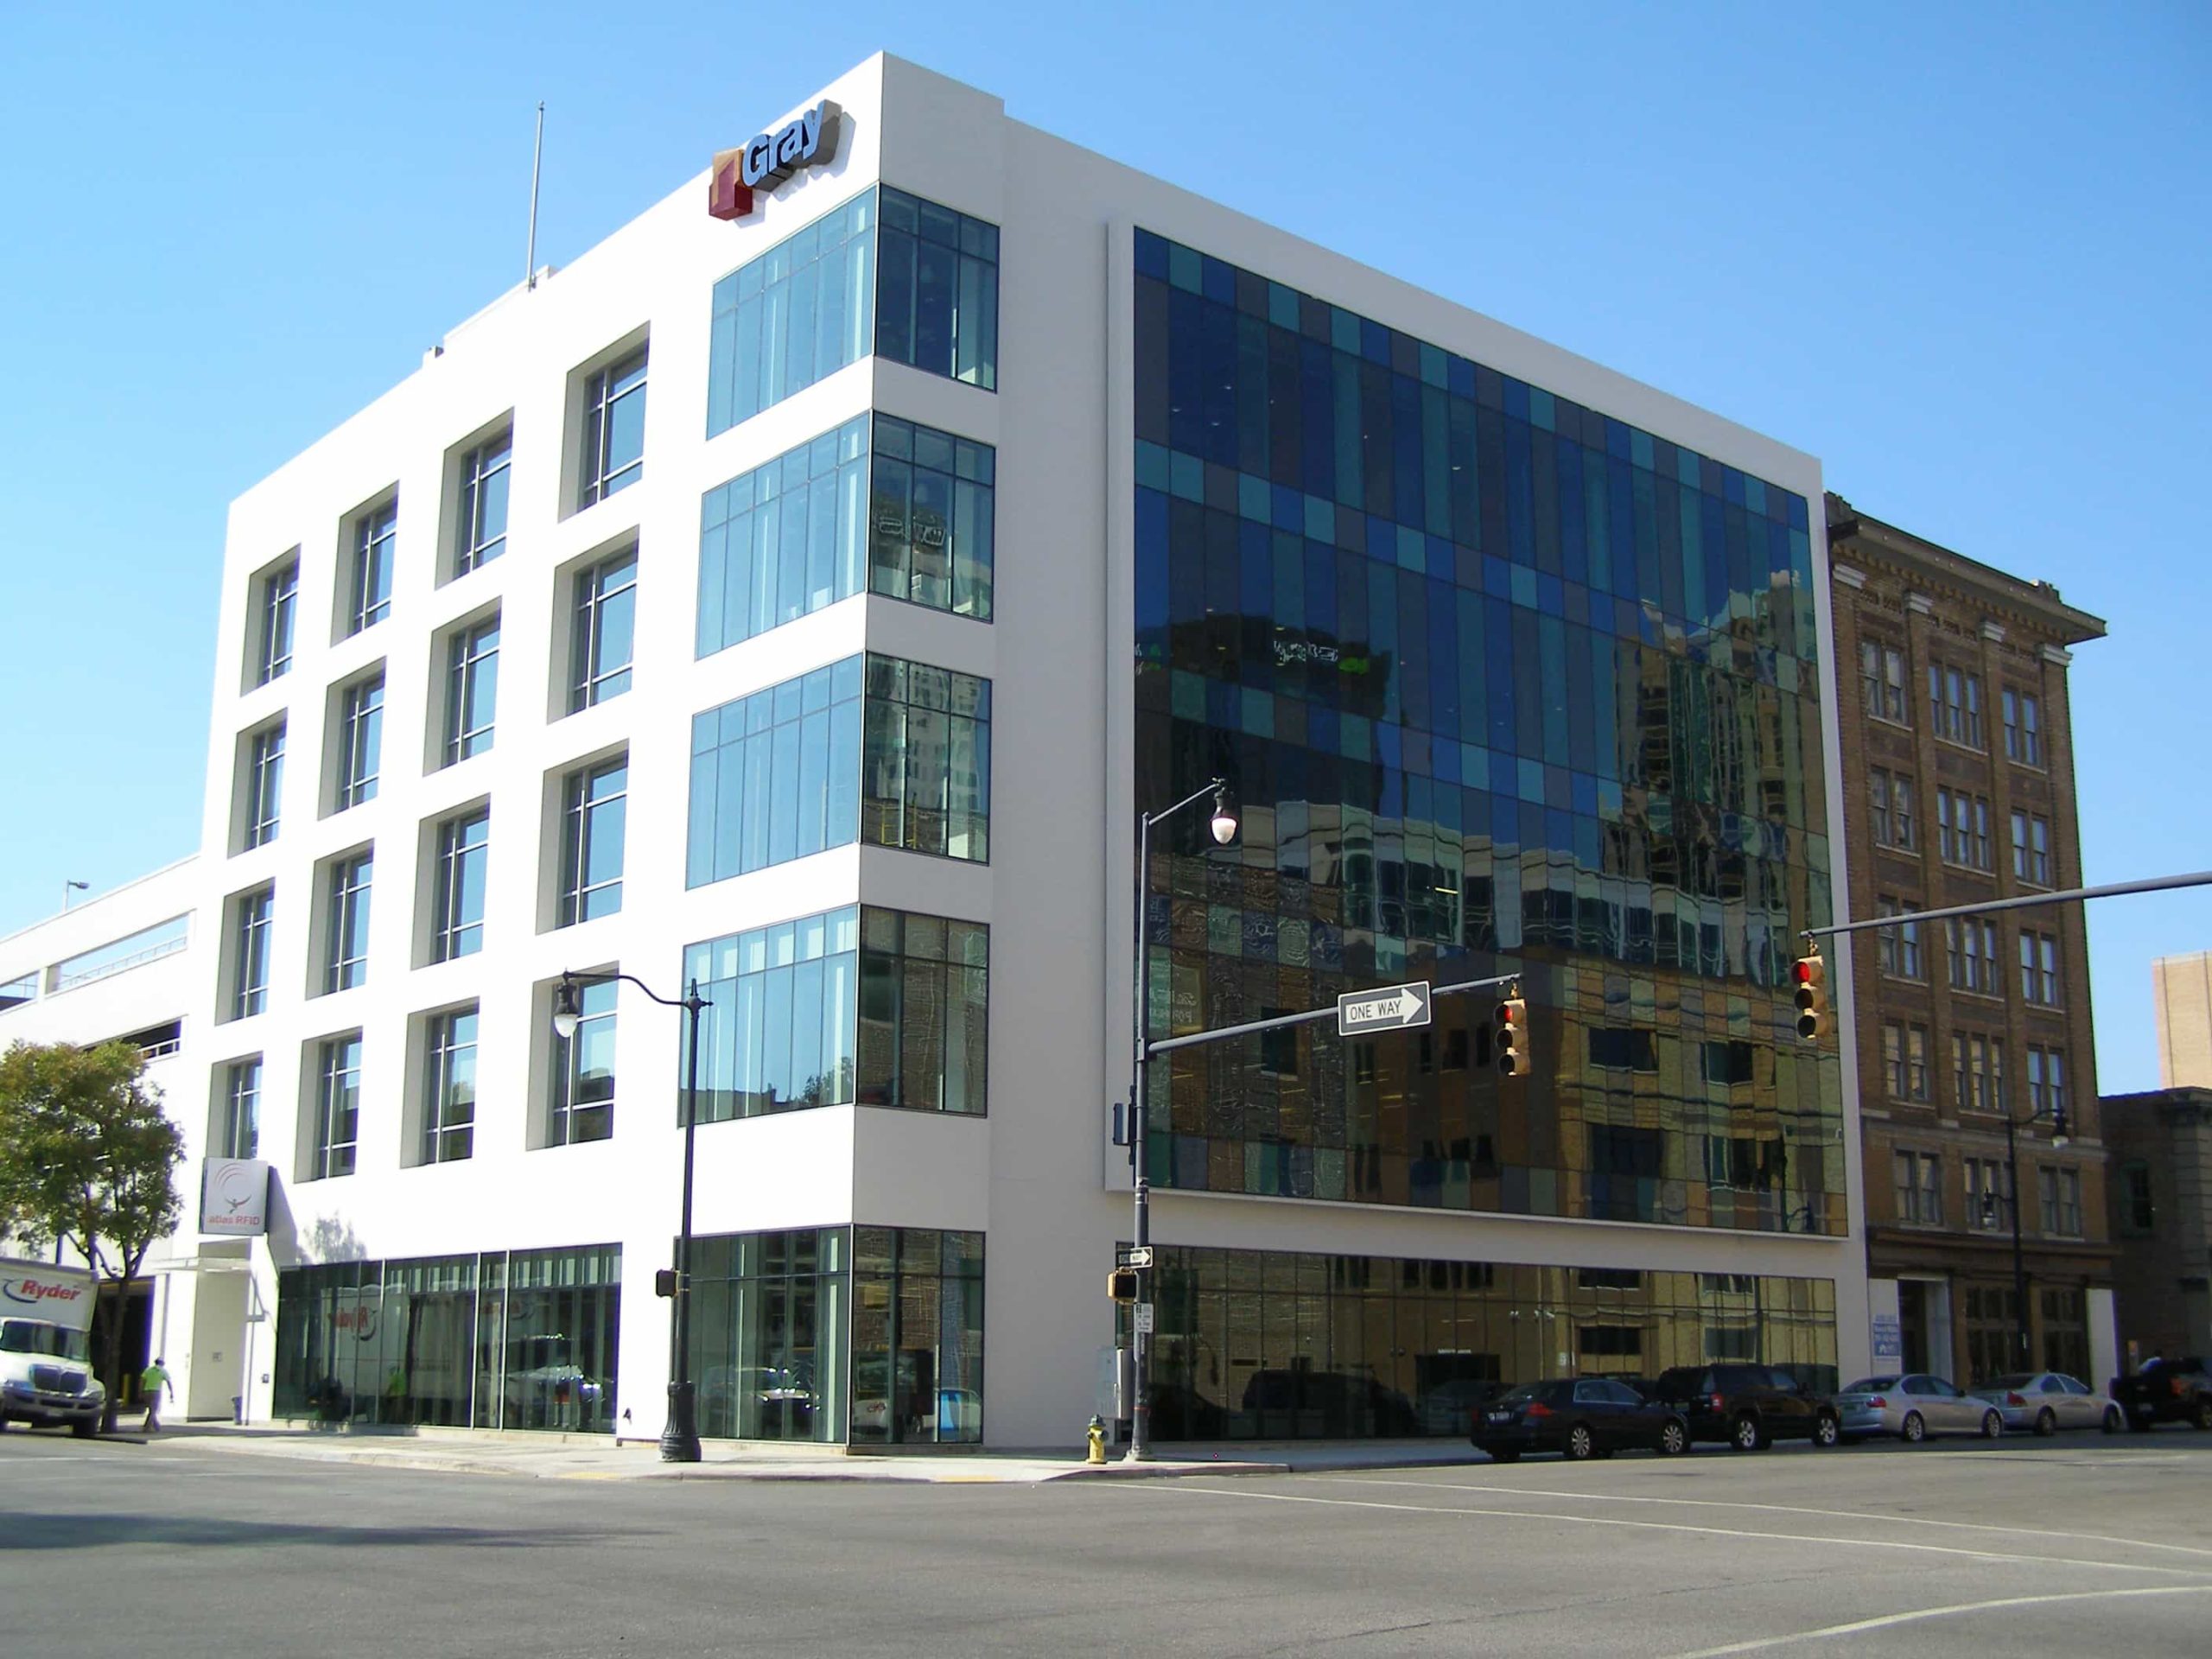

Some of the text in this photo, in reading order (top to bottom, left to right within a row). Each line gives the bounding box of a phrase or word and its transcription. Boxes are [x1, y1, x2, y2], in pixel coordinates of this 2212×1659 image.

[741, 99, 839, 190] Gray
[1351, 999, 1402, 1020] ONE WAY
[235, 1216, 260, 1225] RFID
[22, 1279, 81, 1300] Ryder
